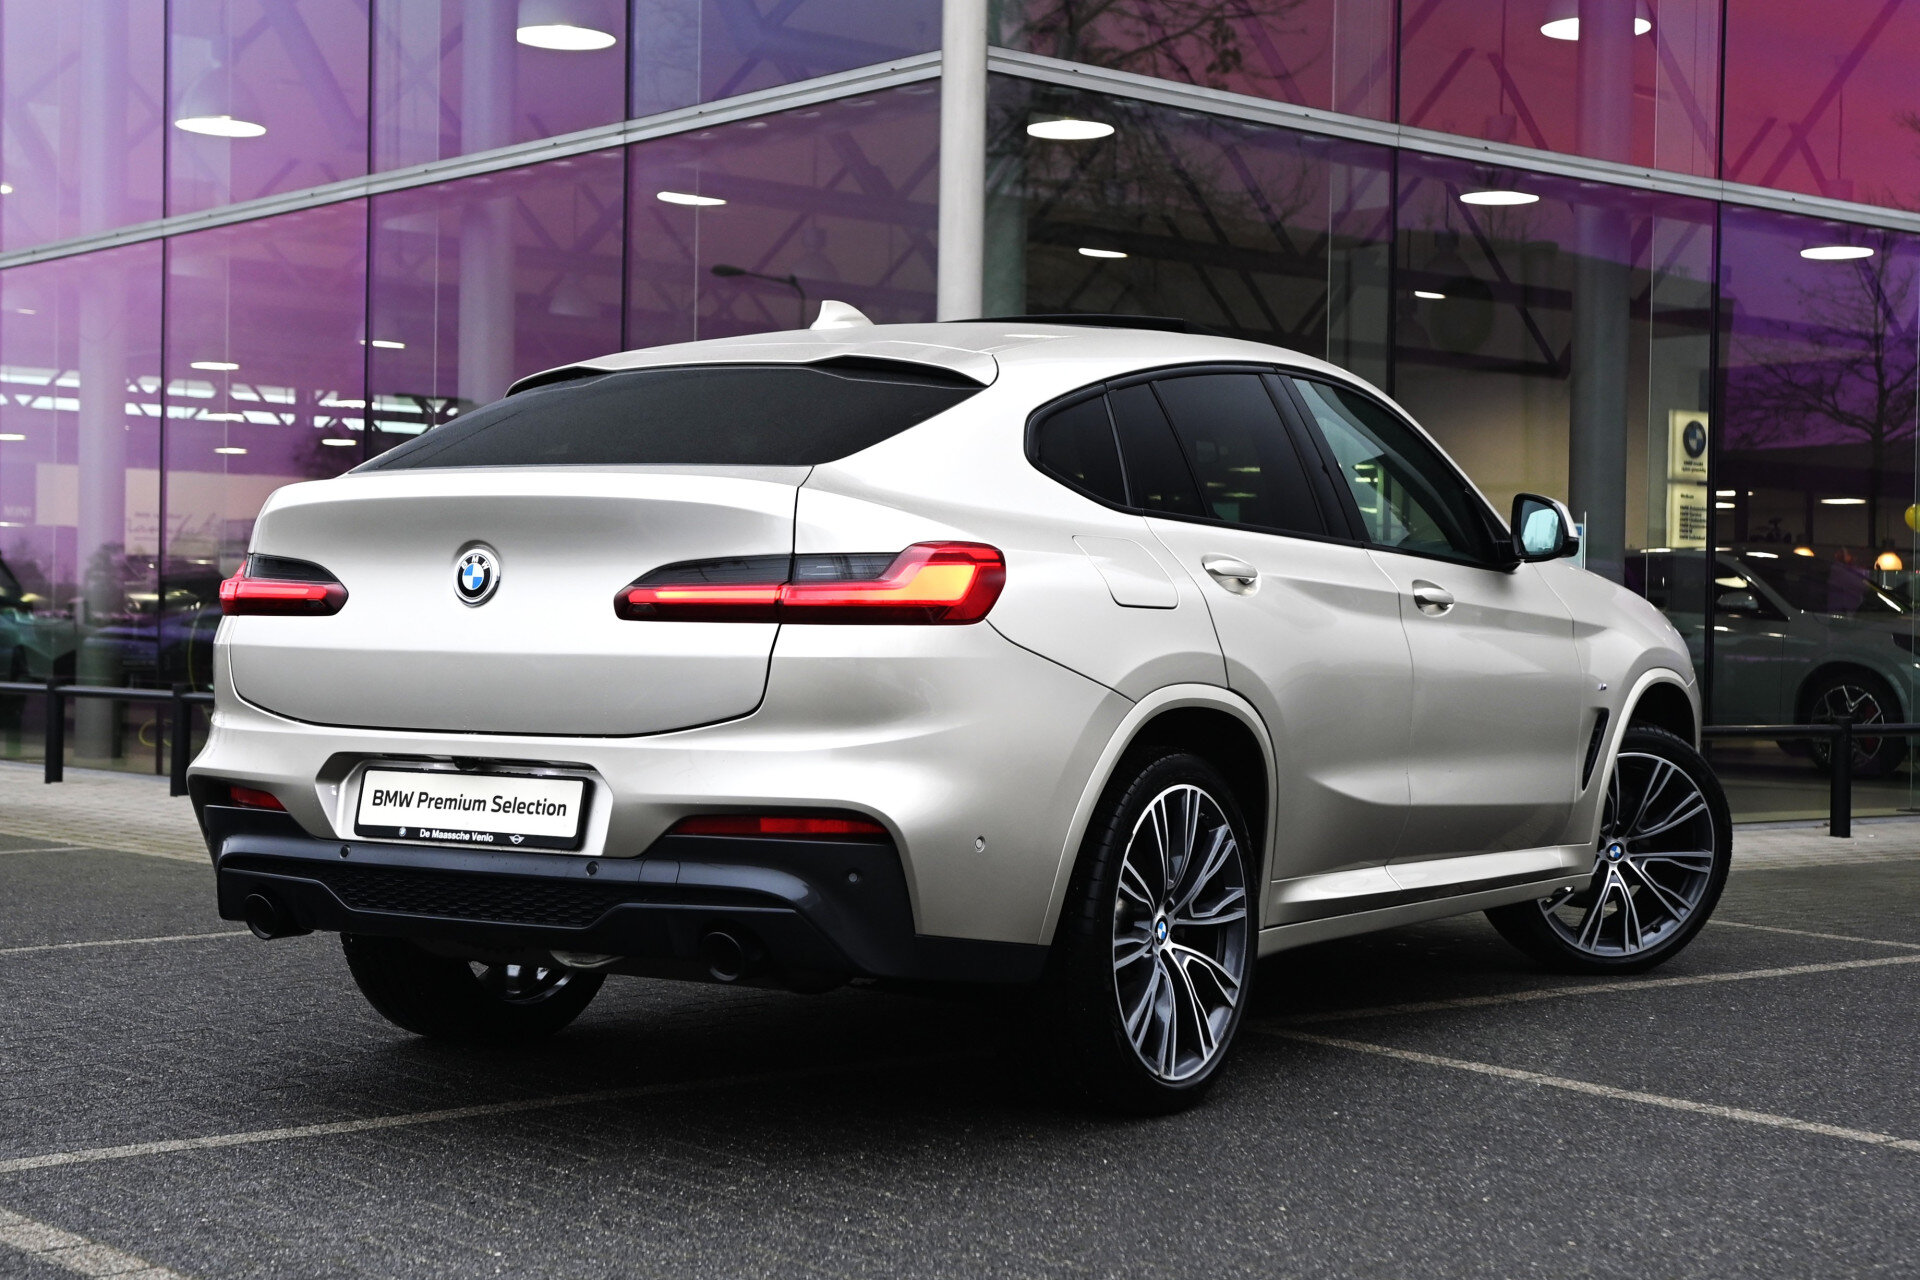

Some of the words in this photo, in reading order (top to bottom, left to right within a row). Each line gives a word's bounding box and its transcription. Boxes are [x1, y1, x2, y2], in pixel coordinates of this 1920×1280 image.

[372, 789, 415, 808] BMW
[417, 791, 487, 812] Premium
[490, 795, 567, 816] Selection
[419, 829, 431, 838] De
[431, 830, 470, 841] Maassche
[471, 832, 494, 842] Venlo
